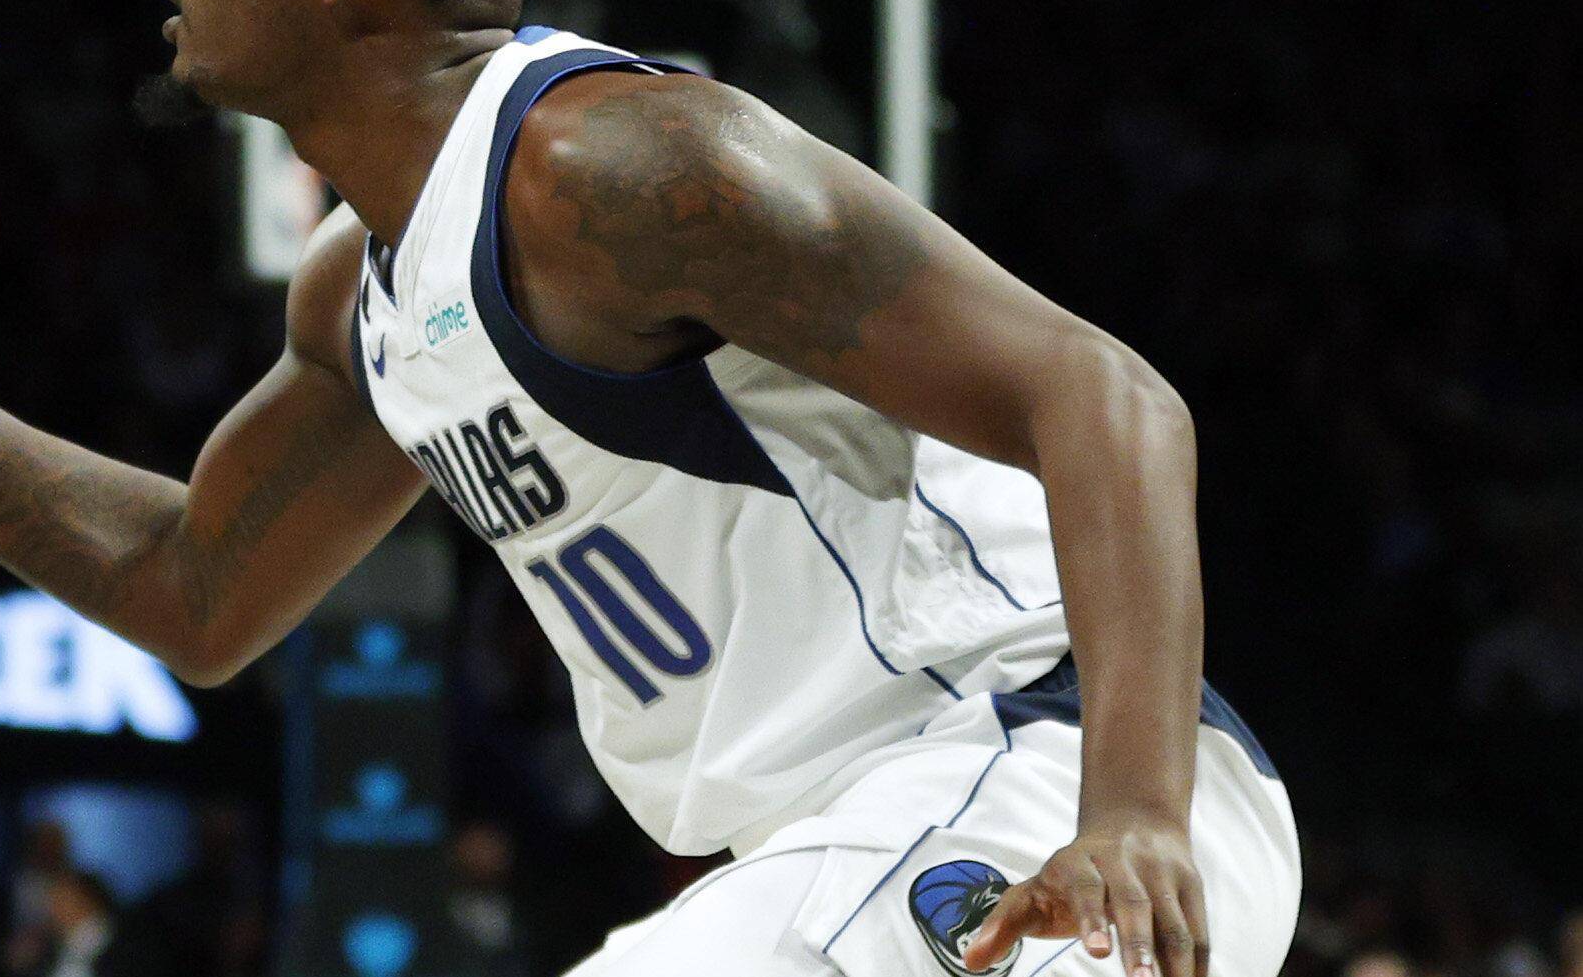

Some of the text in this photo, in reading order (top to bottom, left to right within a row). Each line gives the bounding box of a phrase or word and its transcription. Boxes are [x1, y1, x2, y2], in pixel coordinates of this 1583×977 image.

[425, 300, 469, 347] chime
[406, 398, 571, 543] ALLAS
[526, 523, 717, 708] 10
